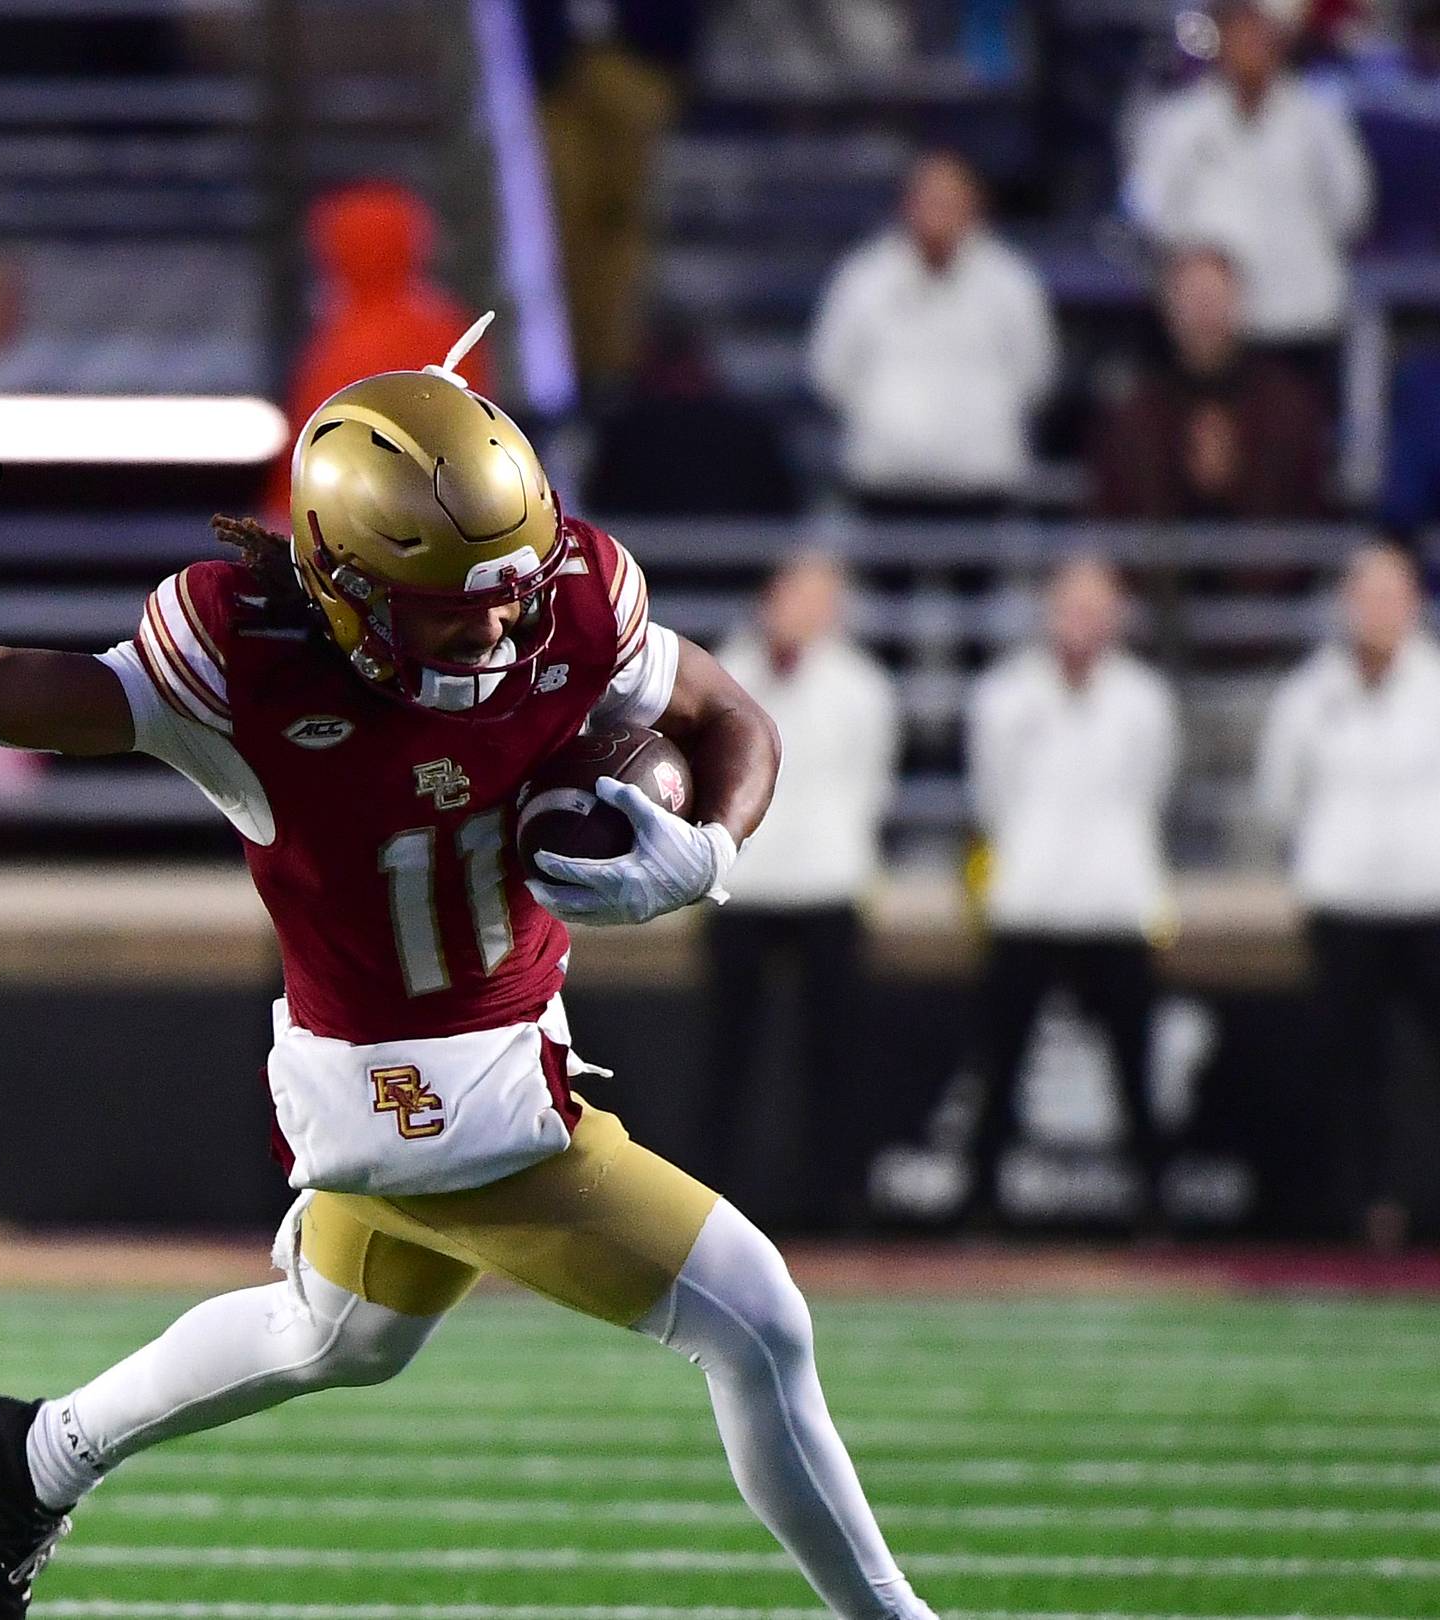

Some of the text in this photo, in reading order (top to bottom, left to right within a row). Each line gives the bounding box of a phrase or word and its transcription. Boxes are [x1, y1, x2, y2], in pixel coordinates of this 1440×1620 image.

[292, 721, 344, 739] ACC
[413, 757, 471, 811] BC
[377, 810, 515, 998] 11
[370, 1064, 445, 1140] BC
